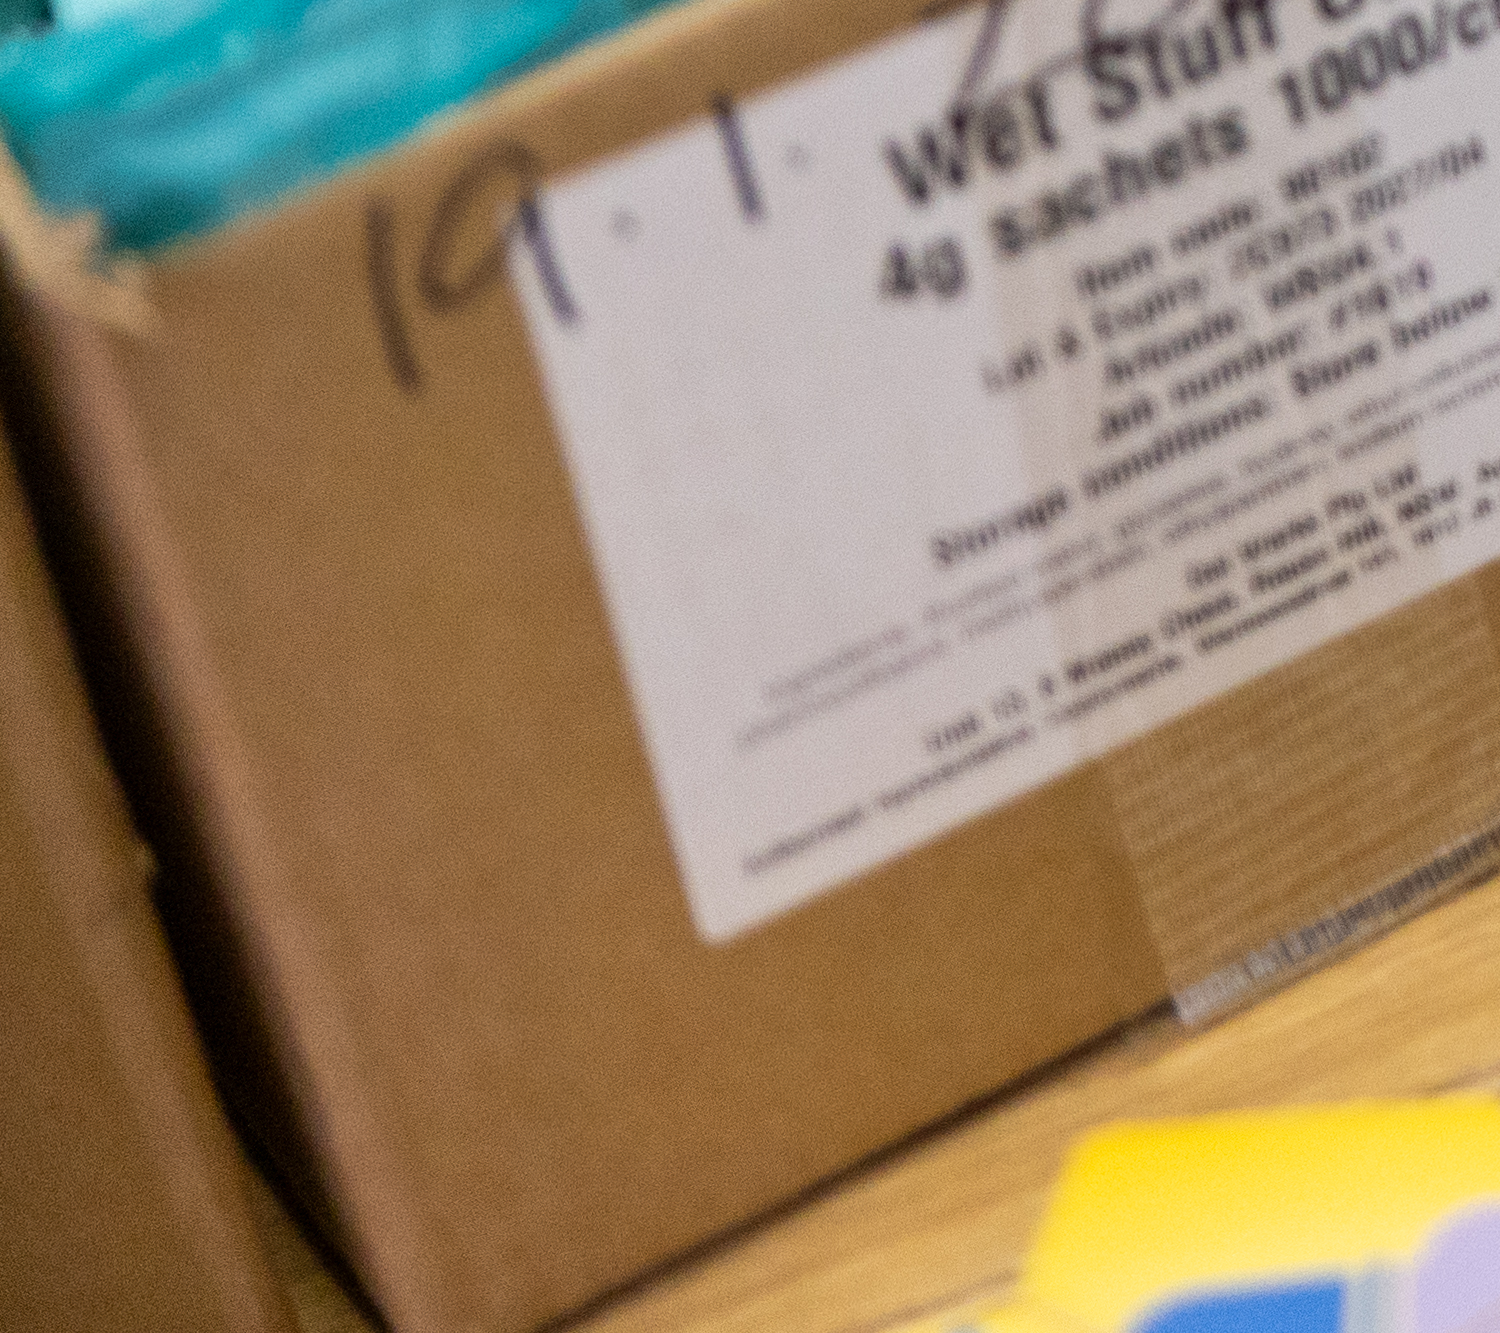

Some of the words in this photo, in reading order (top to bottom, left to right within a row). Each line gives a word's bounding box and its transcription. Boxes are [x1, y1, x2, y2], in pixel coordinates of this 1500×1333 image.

[871, 216, 970, 326] 4g
[990, 93, 1249, 264] sachets
[878, 65, 1062, 217] Wet
